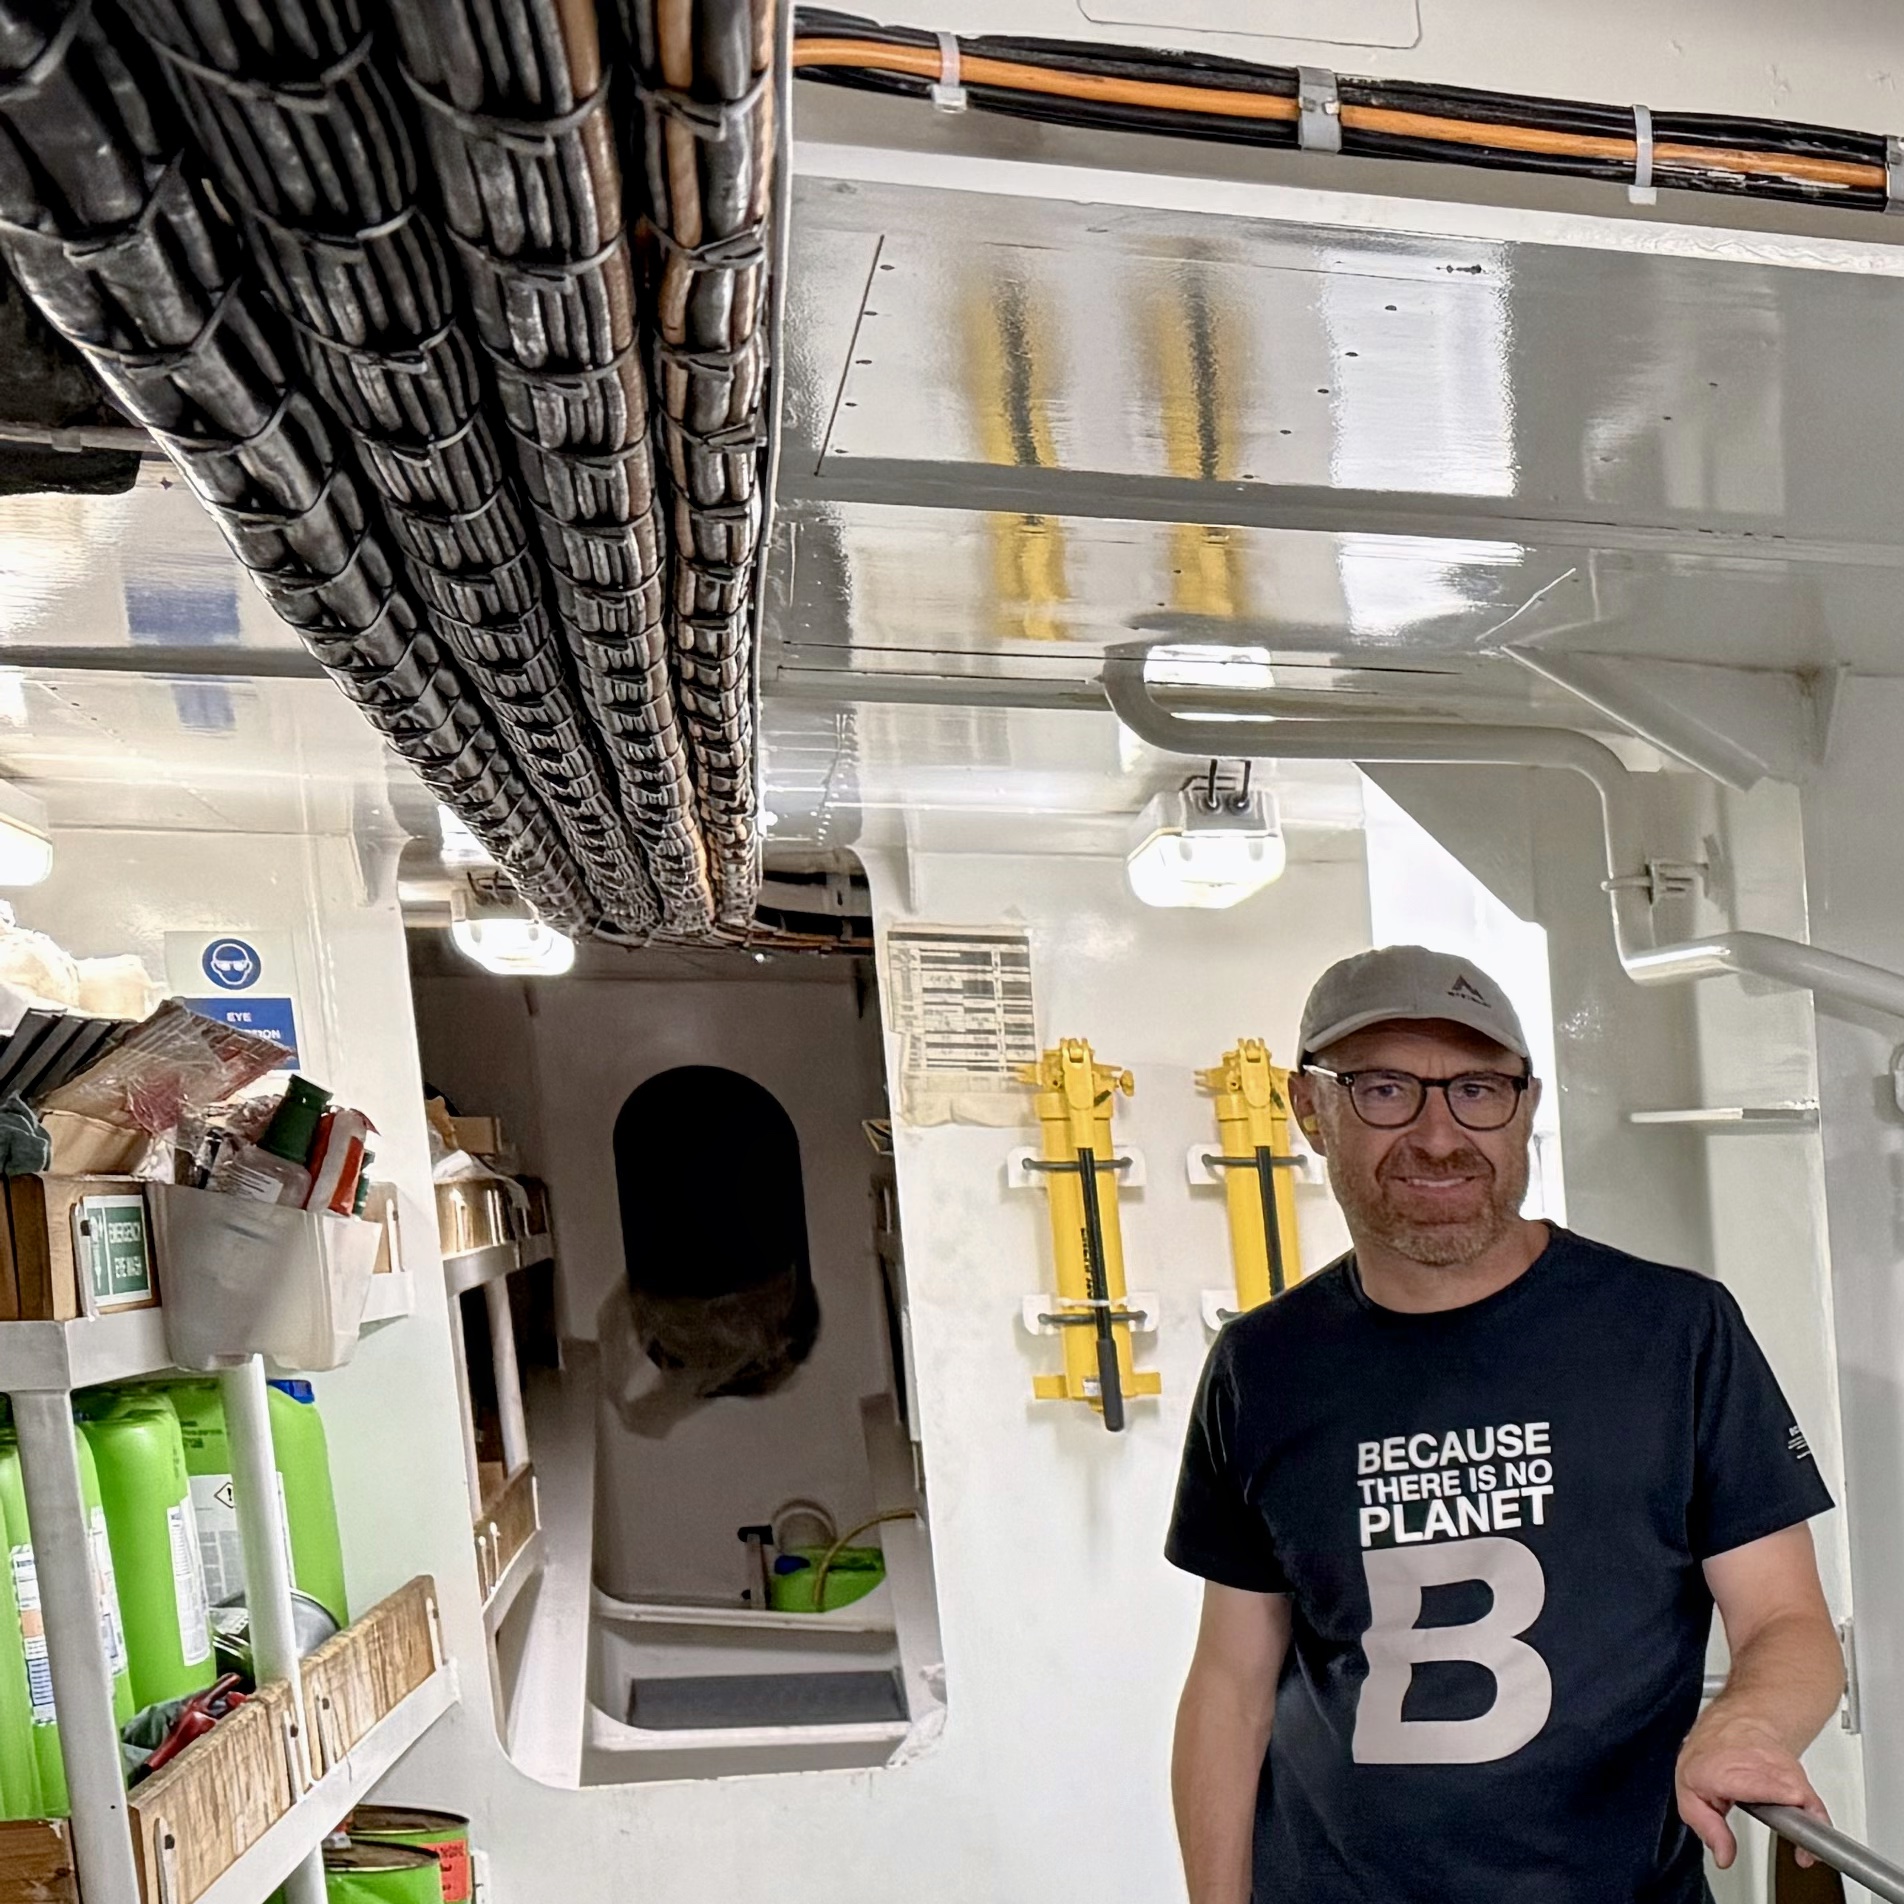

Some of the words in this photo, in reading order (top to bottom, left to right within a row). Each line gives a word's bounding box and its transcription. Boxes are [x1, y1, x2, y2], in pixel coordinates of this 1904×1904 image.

[1357, 1421, 1552, 1475] BECAUSE
[1357, 1469, 1462, 1505] THERE
[1468, 1464, 1498, 1493] IS
[1504, 1458, 1554, 1487] NO
[1359, 1484, 1554, 1548] PLANET
[1353, 1535, 1553, 1764] B
